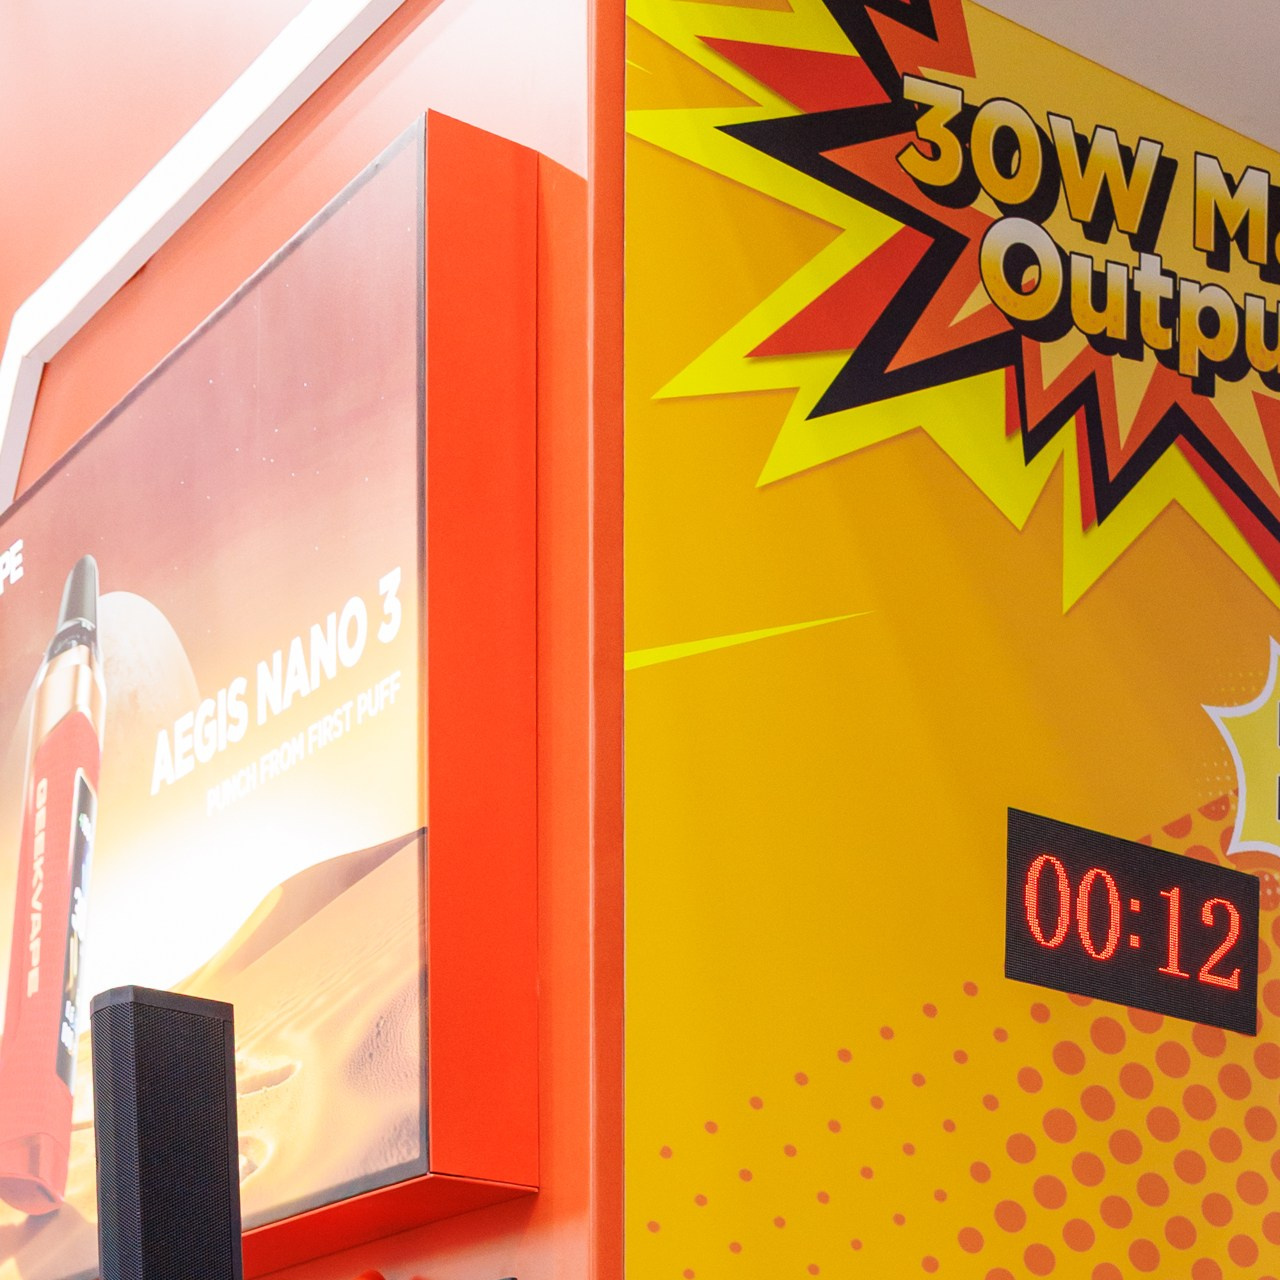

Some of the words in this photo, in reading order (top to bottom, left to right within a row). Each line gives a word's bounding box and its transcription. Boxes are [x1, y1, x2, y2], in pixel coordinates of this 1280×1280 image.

[896, 73, 1168, 238] 30W
[150, 676, 249, 797] AEGIS
[256, 596, 368, 726] NANO
[377, 566, 402, 644] 3
[259, 731, 304, 786] FROM
[307, 699, 355, 755] FIRST
[357, 669, 401, 725] PUFF
[27, 778, 48, 998] GEEKVAPE
[1024, 854, 1242, 990] 00:12
